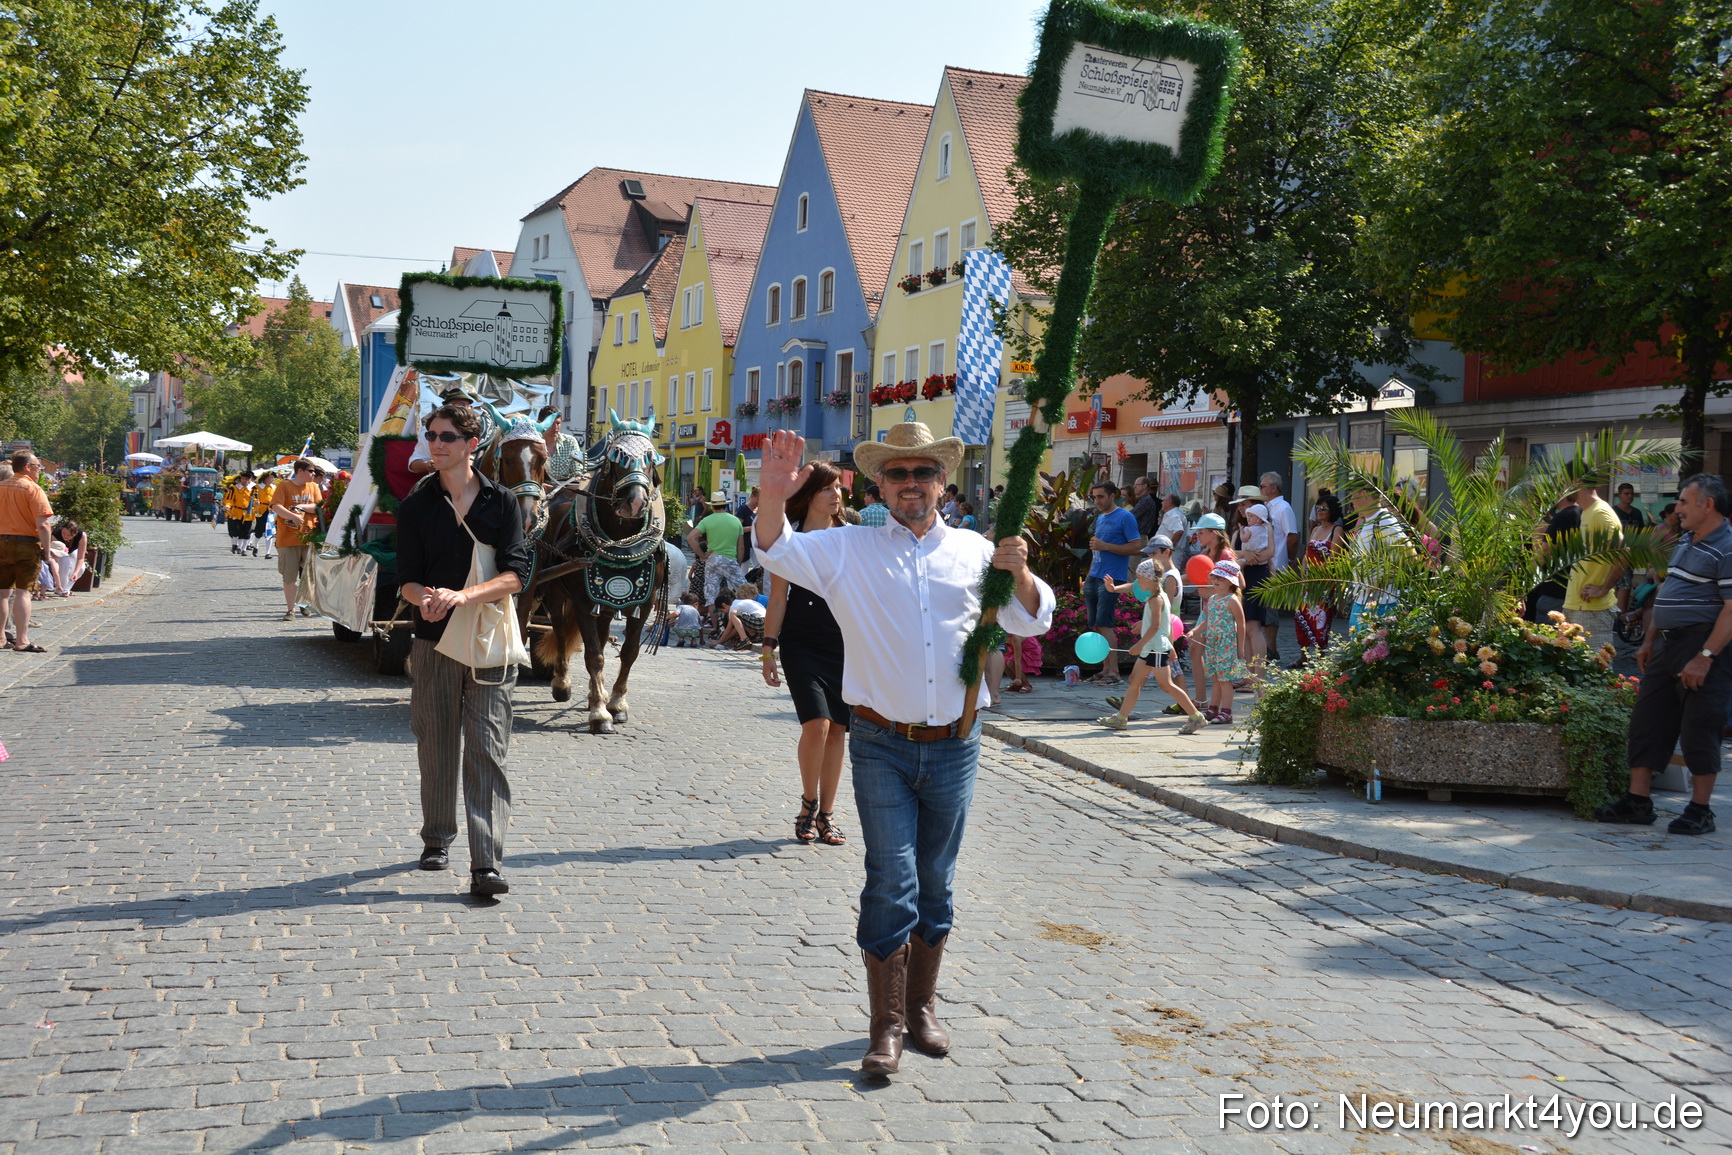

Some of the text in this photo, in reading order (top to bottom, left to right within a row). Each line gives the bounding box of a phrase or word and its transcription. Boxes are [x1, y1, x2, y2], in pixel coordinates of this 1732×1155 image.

[1080, 64, 1149, 89] Schloßspiele
[1078, 81, 1110, 95] Neumarkt
[411, 315, 494, 333] Schloßspiele
[415, 328, 458, 339] Neumarkt
[621, 361, 638, 378] HOTEL
[1014, 363, 1030, 371] KINO
